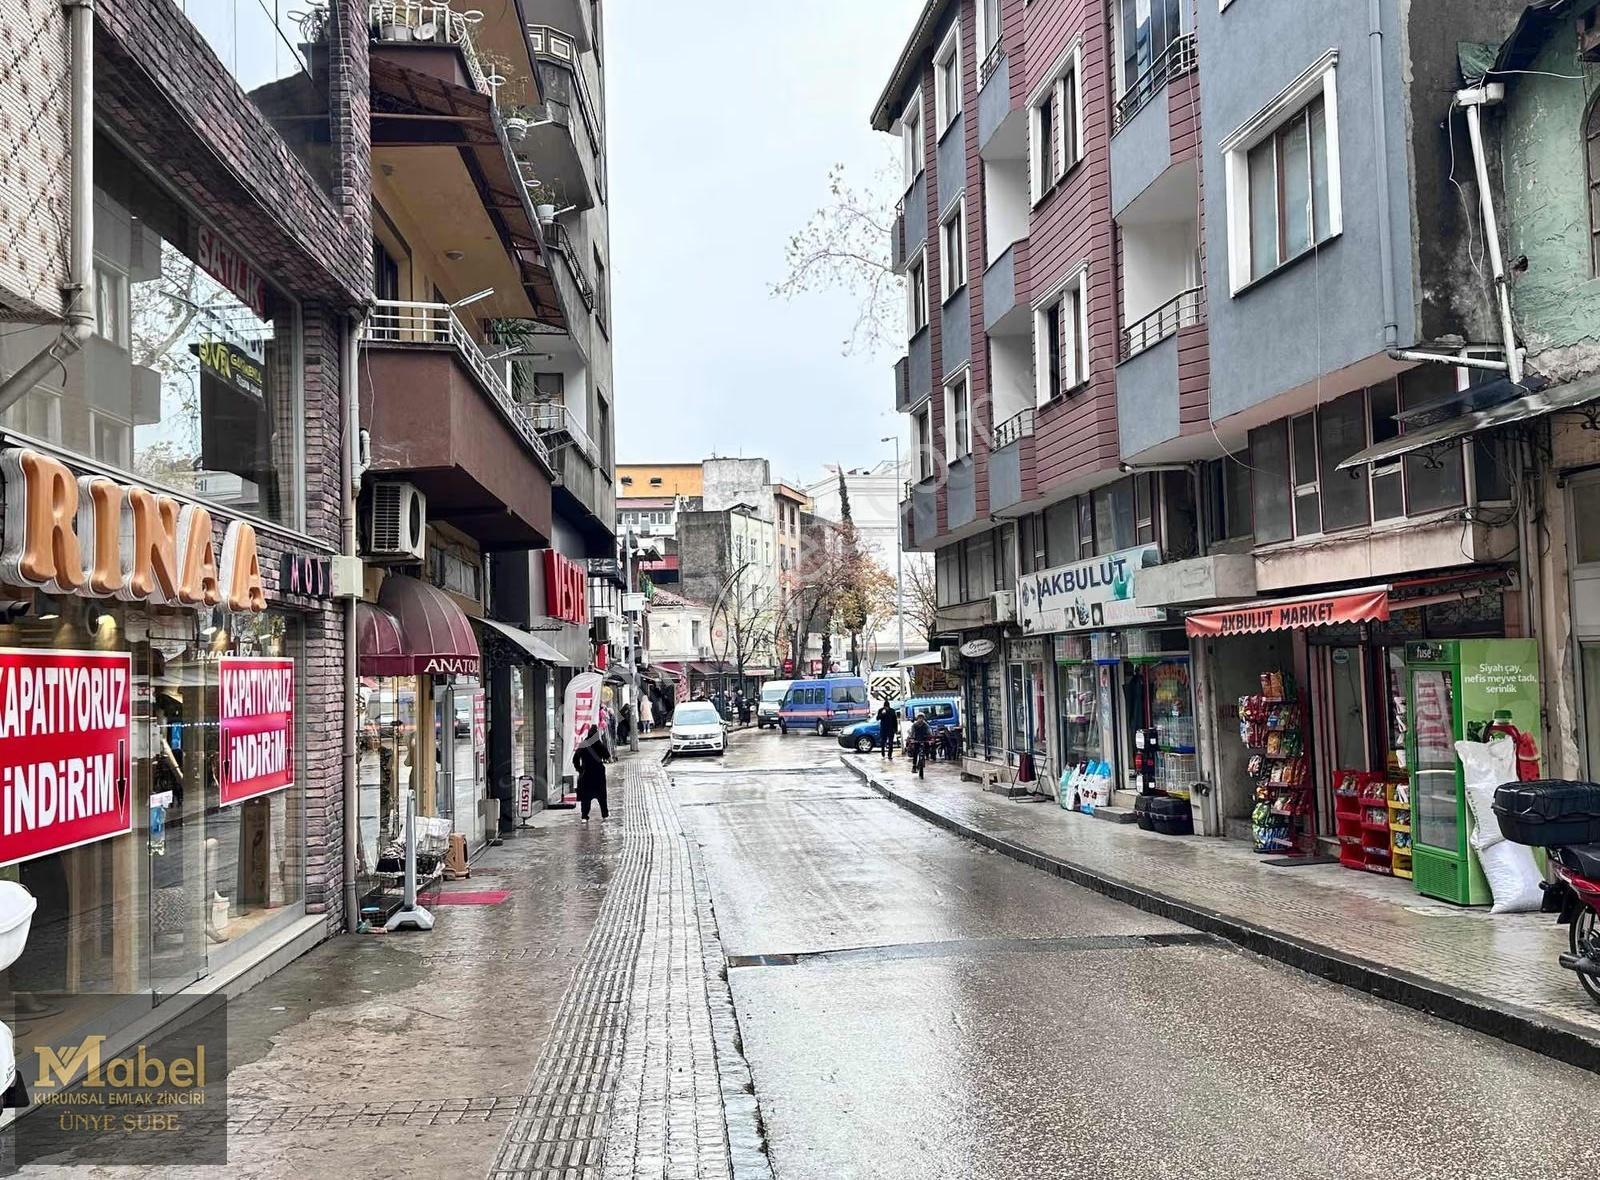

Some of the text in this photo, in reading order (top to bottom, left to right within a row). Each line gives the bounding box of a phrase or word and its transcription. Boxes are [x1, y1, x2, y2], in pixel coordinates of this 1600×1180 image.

[1041, 559, 1126, 598] AKBULUT
[1220, 603, 1334, 632] AKBULUT MARKET
[1464, 673, 1486, 683] nefis
[1488, 674, 1516, 684] meyve
[1480, 663, 1521, 675] Siyah çay,
[223, 669, 291, 719] KAPATIYORUZ
[1486, 683, 1516, 693] serinlik
